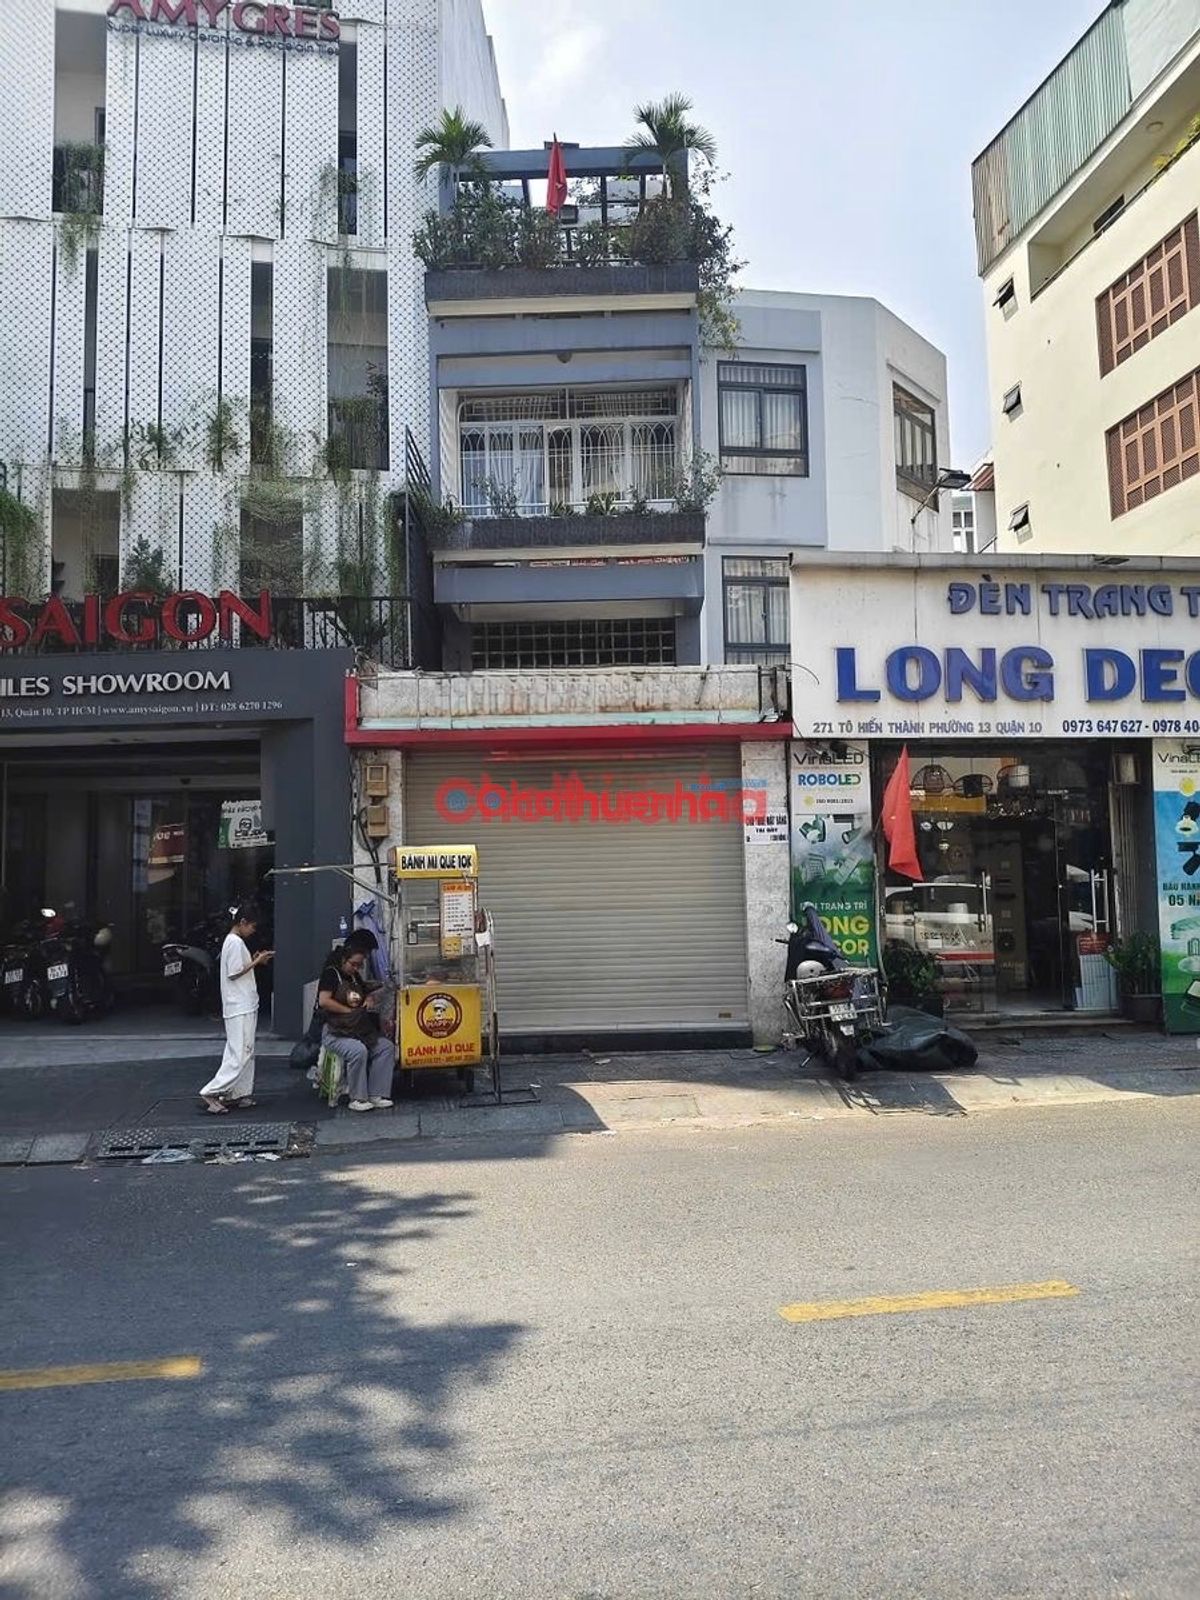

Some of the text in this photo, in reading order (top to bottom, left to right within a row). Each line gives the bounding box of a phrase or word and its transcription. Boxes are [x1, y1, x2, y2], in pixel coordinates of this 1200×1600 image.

[106, 0, 340, 41] AMYGRES
[146, 25, 186, 41] Luxury
[947, 574, 1031, 615] ĐÈN
[1041, 582, 1173, 619] TRANG
[0, 589, 272, 647] SAIGON
[62, 670, 231, 695] SHOWROOM
[835, 645, 1055, 703] LONG
[813, 716, 1043, 736] 271 TÔ HIẾN THÀNH PHƯỜNG 13 QUẬN 10
[1062, 719, 1093, 734] 0973
[1096, 719, 1119, 733] 647
[1120, 719, 1143, 733] 627
[1152, 718, 1182, 733] 0978
[797, 773, 862, 786] ROBOLED
[458, 854, 472, 868] 10K
[1169, 894, 1184, 906] 05
